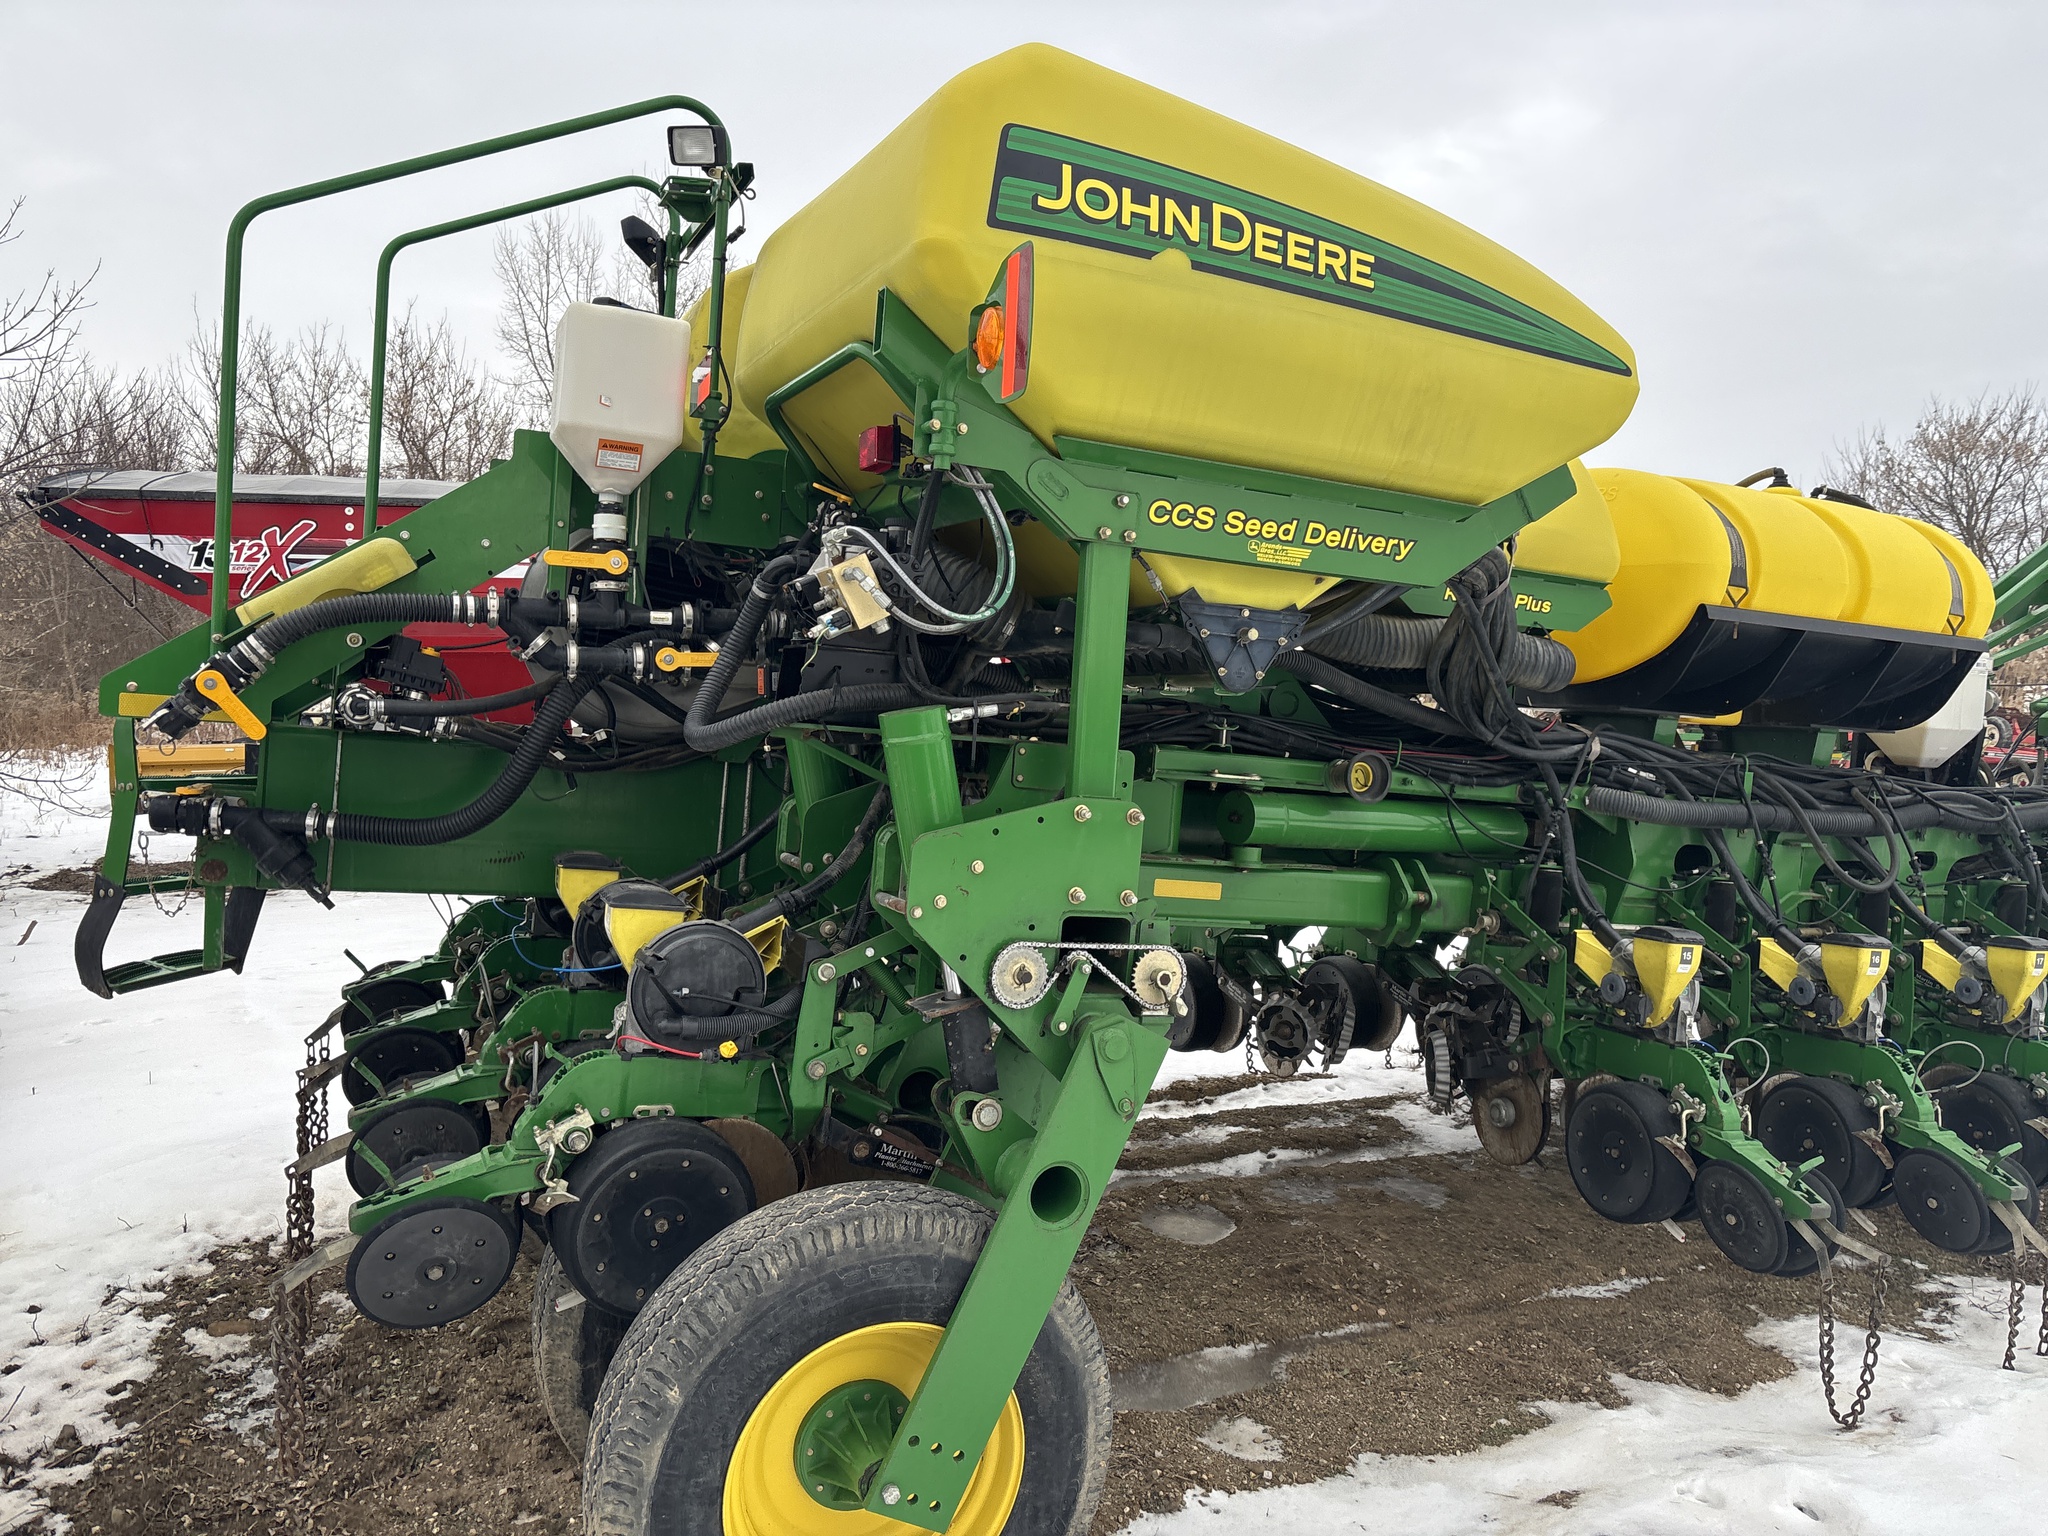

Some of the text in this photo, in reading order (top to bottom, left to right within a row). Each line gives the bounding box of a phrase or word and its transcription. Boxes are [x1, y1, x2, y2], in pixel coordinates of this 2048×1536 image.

[1036, 163, 1376, 290] JOHN DEERE
[608, 443, 639, 453] WARNING
[1148, 500, 1416, 562] CCS Seed Delivery
[1514, 593, 1553, 614] Plus
[1682, 951, 1692, 961] 15
[1871, 955, 1881, 964] 16
[2036, 957, 2044, 966] 17
[874, 1151, 934, 1171] Planter ttachments
